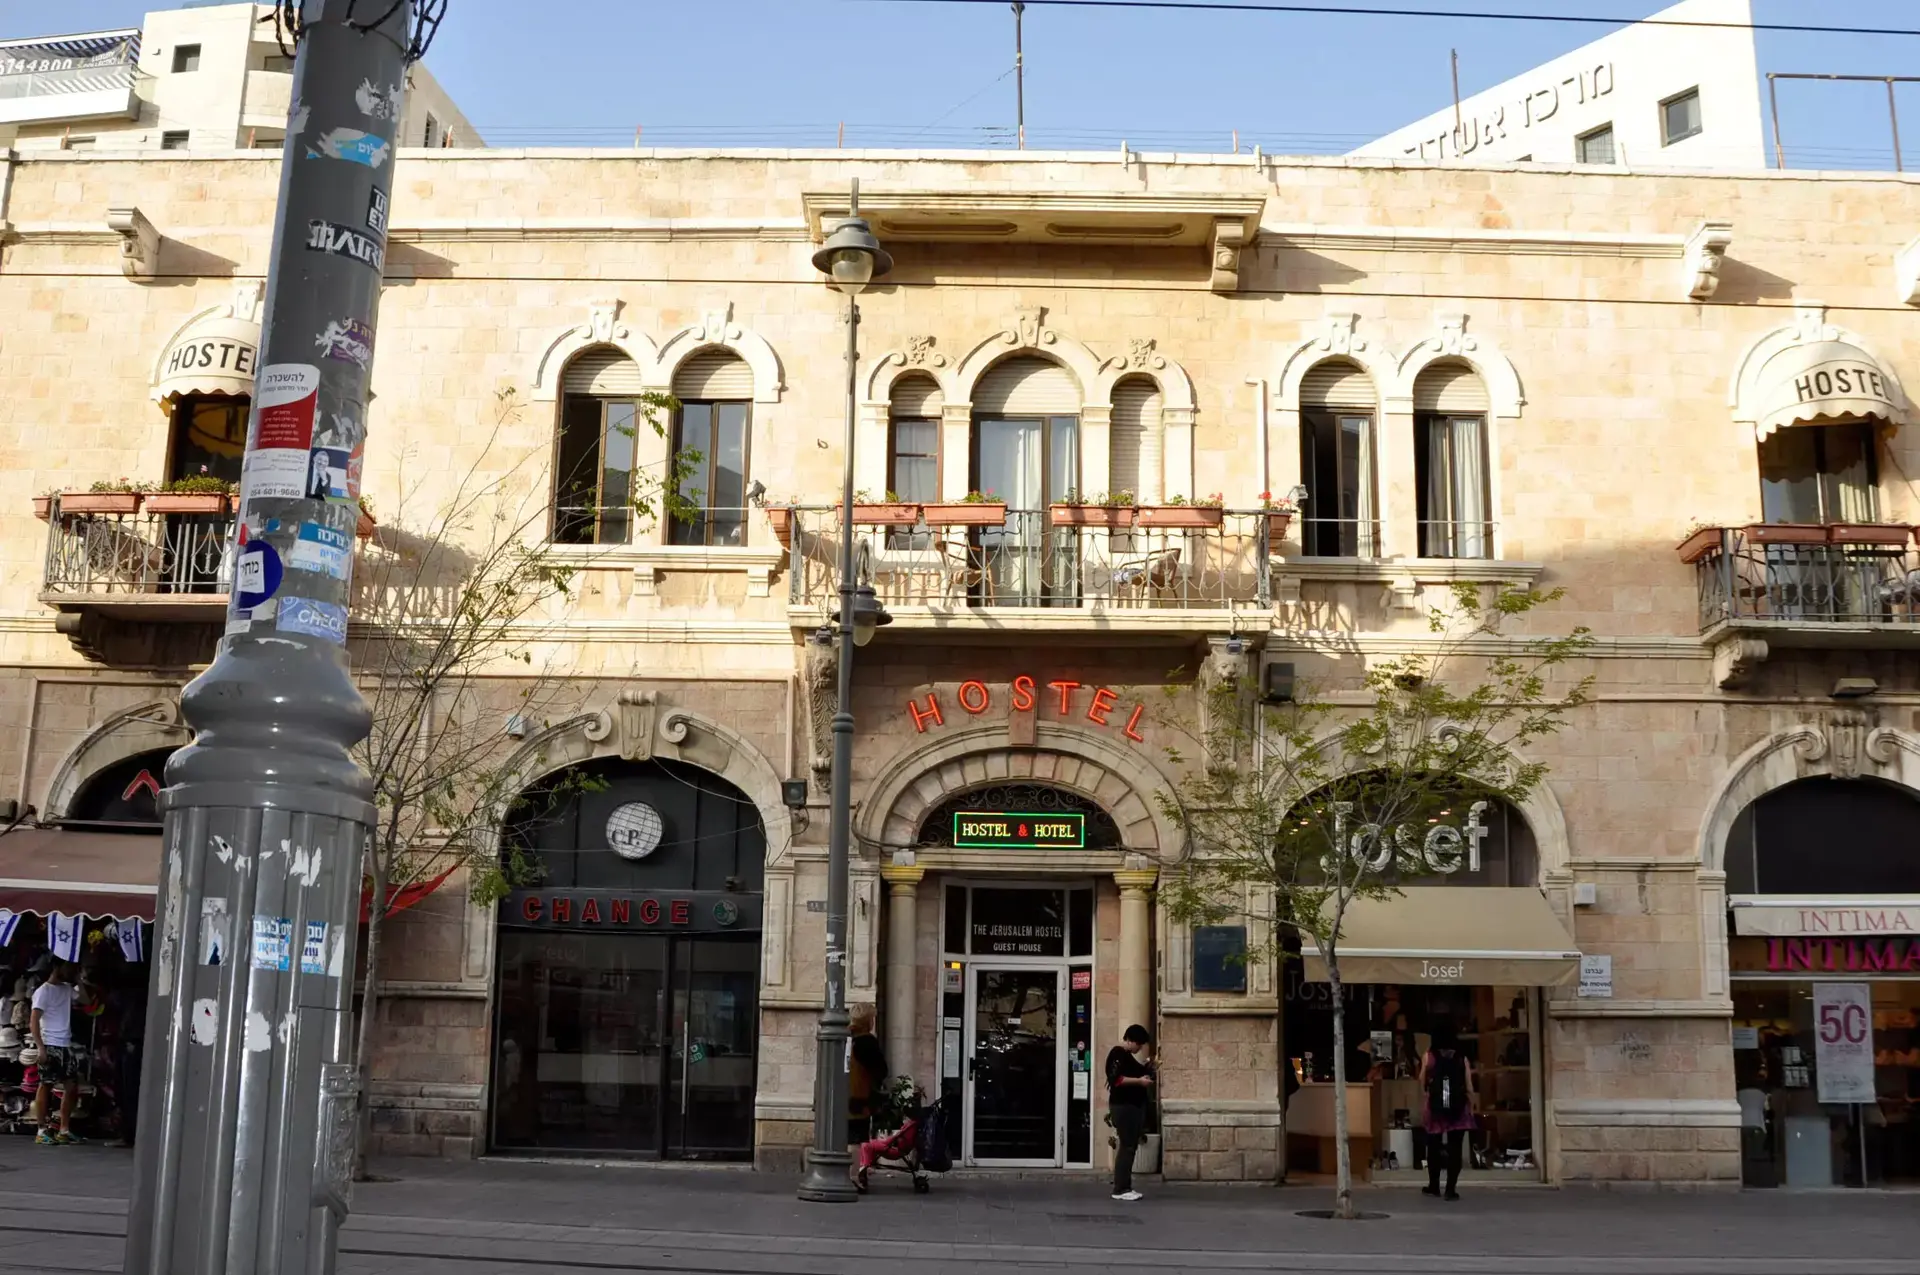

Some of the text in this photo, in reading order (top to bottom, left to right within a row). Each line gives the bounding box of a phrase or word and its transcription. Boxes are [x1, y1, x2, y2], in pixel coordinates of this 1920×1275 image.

[1518, 62, 1613, 128] מרכז
[266, 372, 305, 383] להשכרה
[909, 675, 1145, 743] HOSTEL
[611, 829, 641, 846] C.P.
[962, 823, 1075, 838] HOSTEL & HOTEL
[1319, 800, 1489, 874] Josef
[521, 896, 691, 925] CHANGE
[1799, 910, 1914, 932] INTIMA
[973, 924, 1062, 938] THE JERUSALEM HOSTEL
[993, 943, 1042, 952] GUEST HOUSE
[1420, 960, 1464, 978] Josef
[1285, 970, 1355, 1002] Jos
[1820, 1004, 1867, 1043] 50
